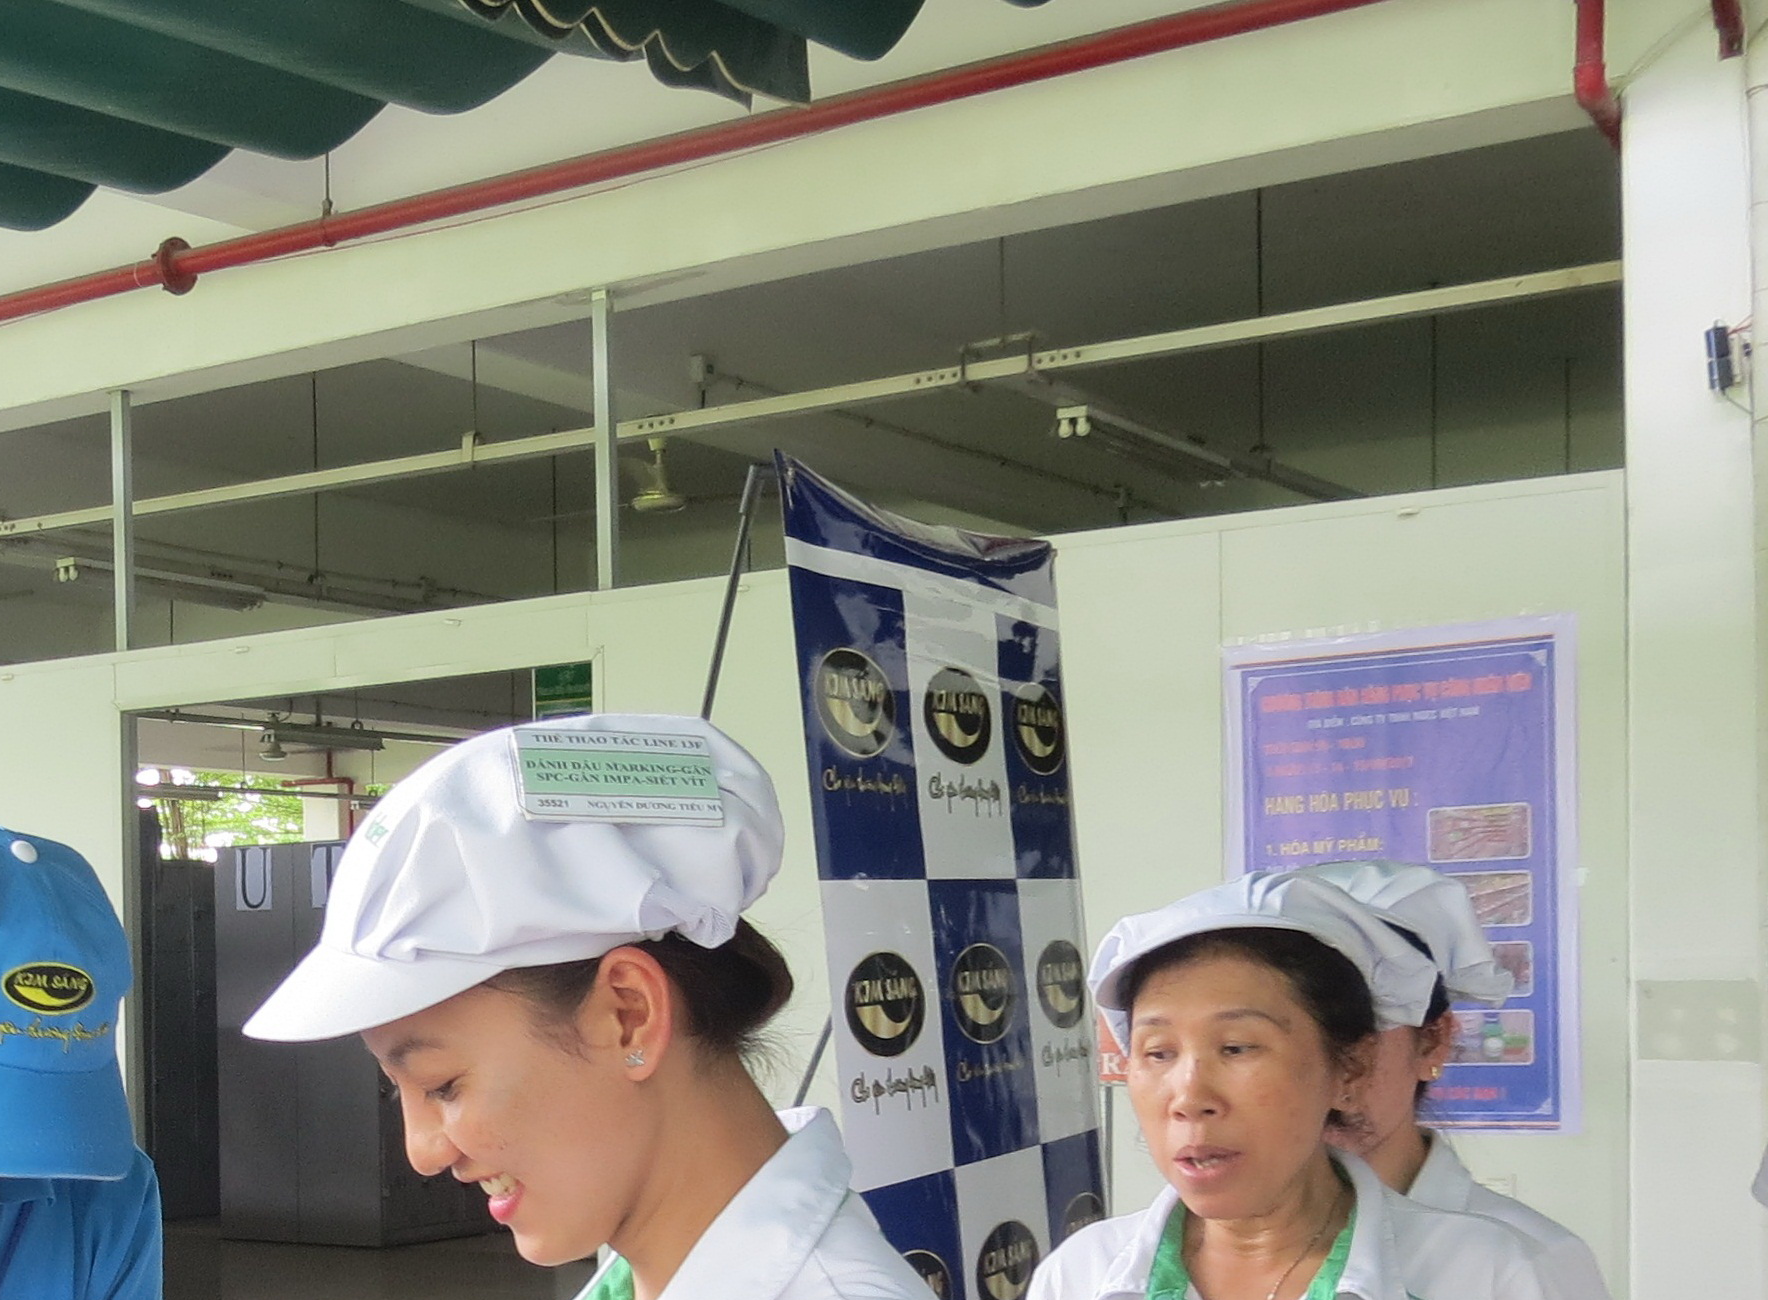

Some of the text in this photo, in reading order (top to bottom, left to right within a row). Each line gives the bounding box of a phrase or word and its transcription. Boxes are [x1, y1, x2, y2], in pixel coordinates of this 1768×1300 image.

[566, 735, 607, 744] THAO
[611, 736, 640, 746] TÁC
[643, 738, 678, 748] LINE
